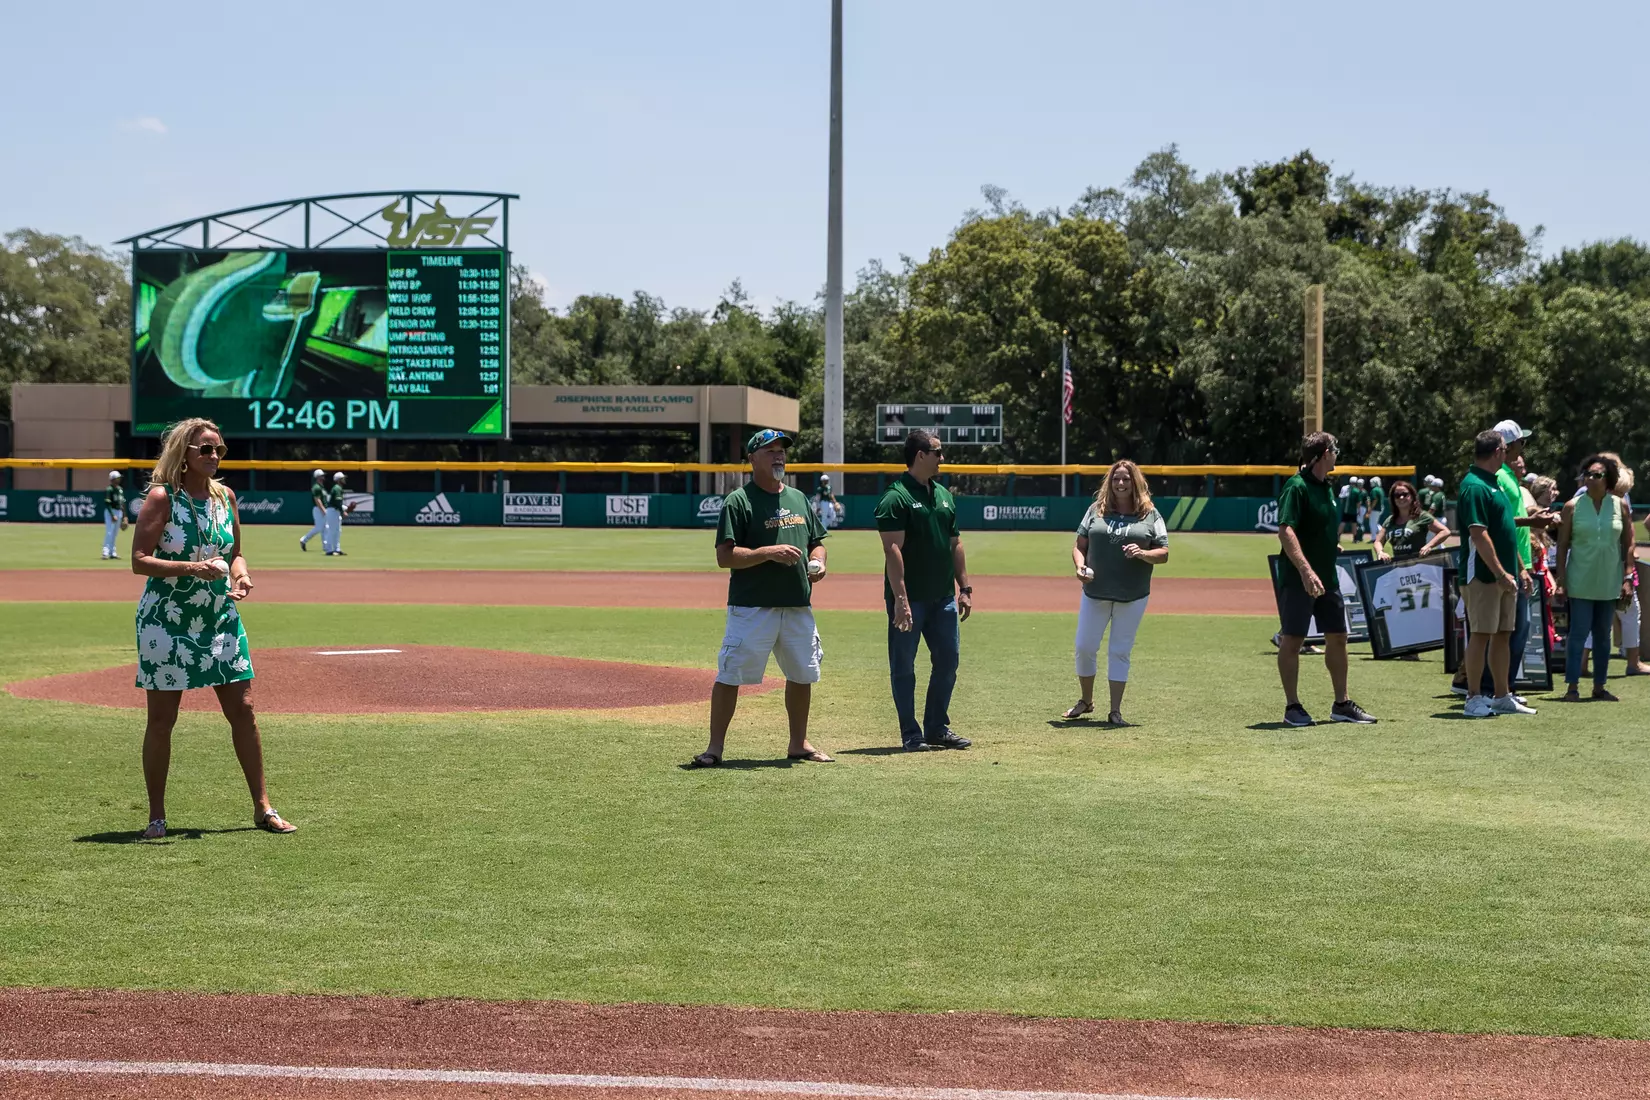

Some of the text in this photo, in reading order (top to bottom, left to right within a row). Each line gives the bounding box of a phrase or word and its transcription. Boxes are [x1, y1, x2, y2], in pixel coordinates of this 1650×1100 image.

[382, 196, 498, 246] USF
[421, 255, 463, 267] TIMELINE
[388, 268, 418, 278] USF BP
[388, 280, 422, 290] WSU BP
[388, 293, 409, 304] WSU
[388, 306, 437, 317] FIELD CREW
[388, 319, 437, 329] SENIOR DAY
[407, 331, 446, 342] MEETING
[388, 345, 455, 356] INTROS/LINEUPS
[405, 358, 431, 369] TAKES
[431, 358, 455, 369] FIELD
[408, 371, 445, 381] ANTHEM
[388, 383, 431, 394] PLAY BALL
[653, 395, 694, 404] CAMPO
[582, 405, 666, 413] BATTING FACILITY
[248, 400, 400, 430] 12:46 PM
[506, 495, 560, 506] TOWER
[610, 498, 646, 514] USF
[37, 496, 97, 519] Times
[998, 506, 1046, 515] HERITAGE
[415, 511, 461, 523] adidas
[606, 515, 648, 525] HEALTH
[764, 516, 806, 529] SOUTH FLORIDA
[1106, 520, 1132, 536] USF
[1399, 573, 1423, 587] CRUZ
[1396, 583, 1432, 612] 37
